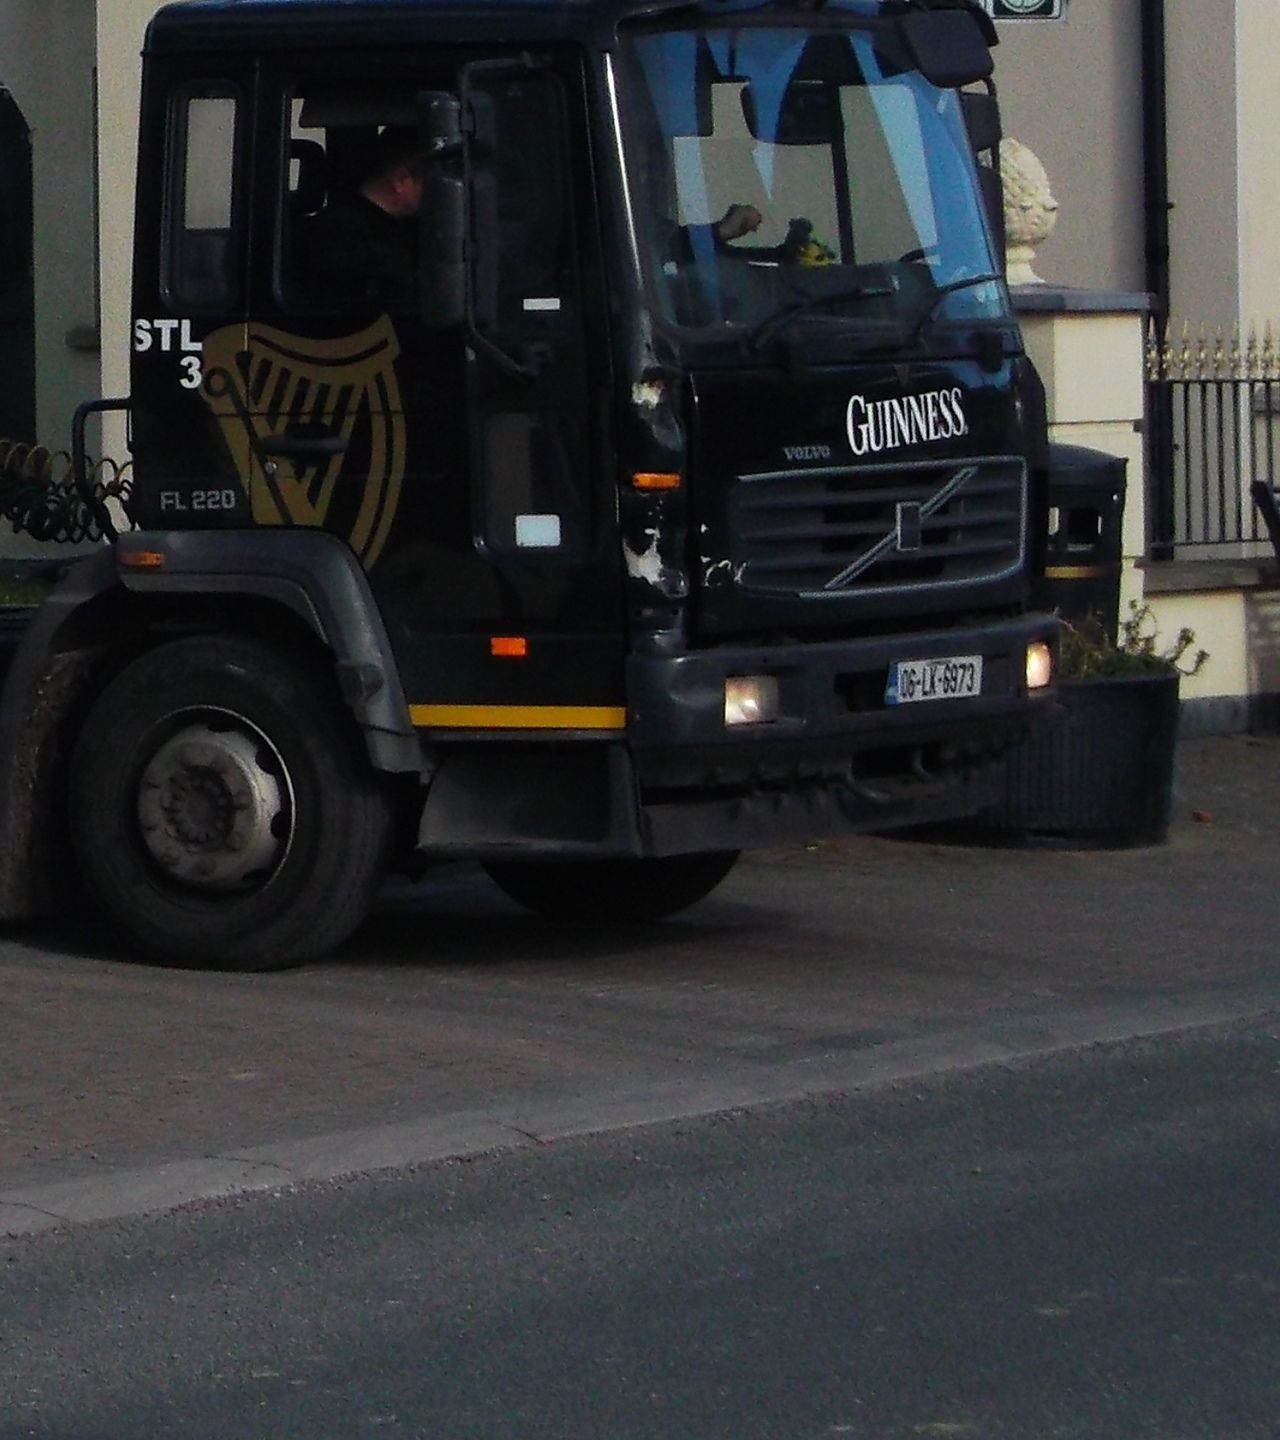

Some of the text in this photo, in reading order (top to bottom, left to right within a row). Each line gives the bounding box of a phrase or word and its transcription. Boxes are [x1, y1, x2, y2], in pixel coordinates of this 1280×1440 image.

[134, 319, 202, 352] STL
[179, 355, 202, 389] 3
[845, 387, 966, 455] GUINNESS
[783, 445, 830, 461] VOLVO
[160, 489, 236, 510] FL 220
